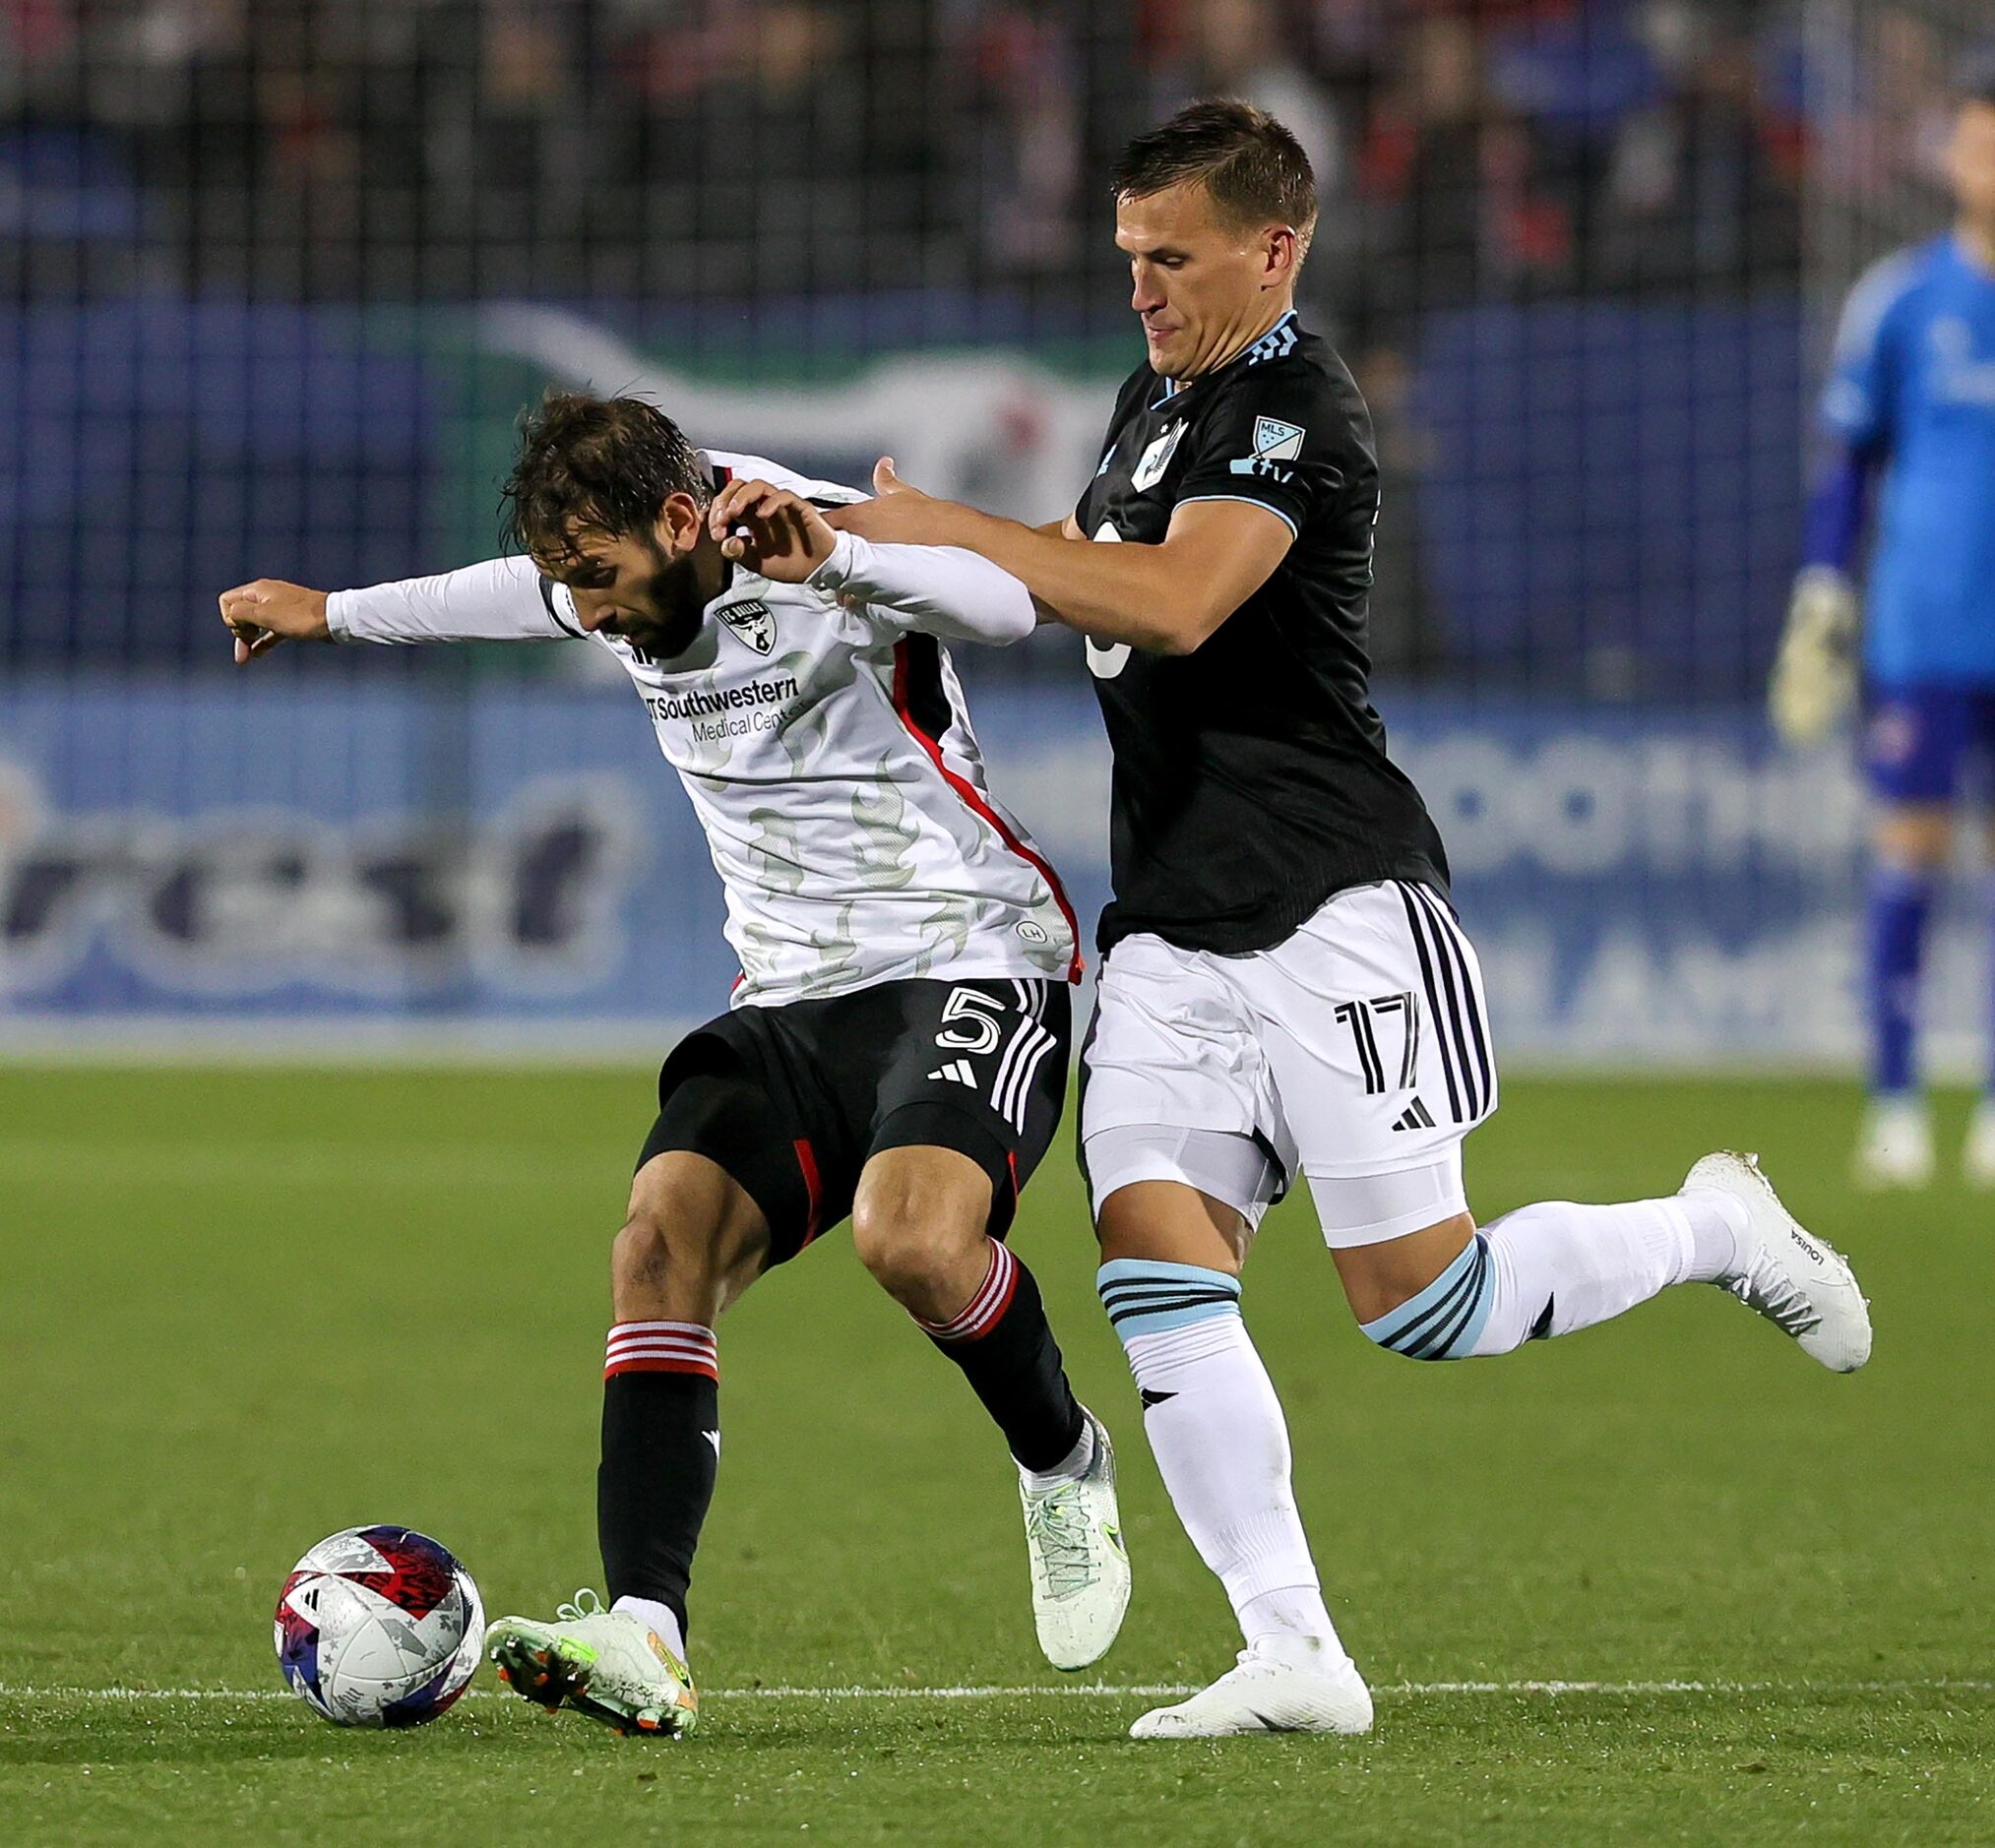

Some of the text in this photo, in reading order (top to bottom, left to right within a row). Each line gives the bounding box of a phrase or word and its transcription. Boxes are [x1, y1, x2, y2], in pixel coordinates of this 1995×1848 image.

[1261, 422, 1285, 436] MLS
[692, 708, 752, 743] Medical
[1022, 928, 1042, 939] LH
[935, 986, 1007, 1055] 5
[1334, 991, 1420, 1094] 17
[1791, 1228, 1825, 1265] LOUISA
